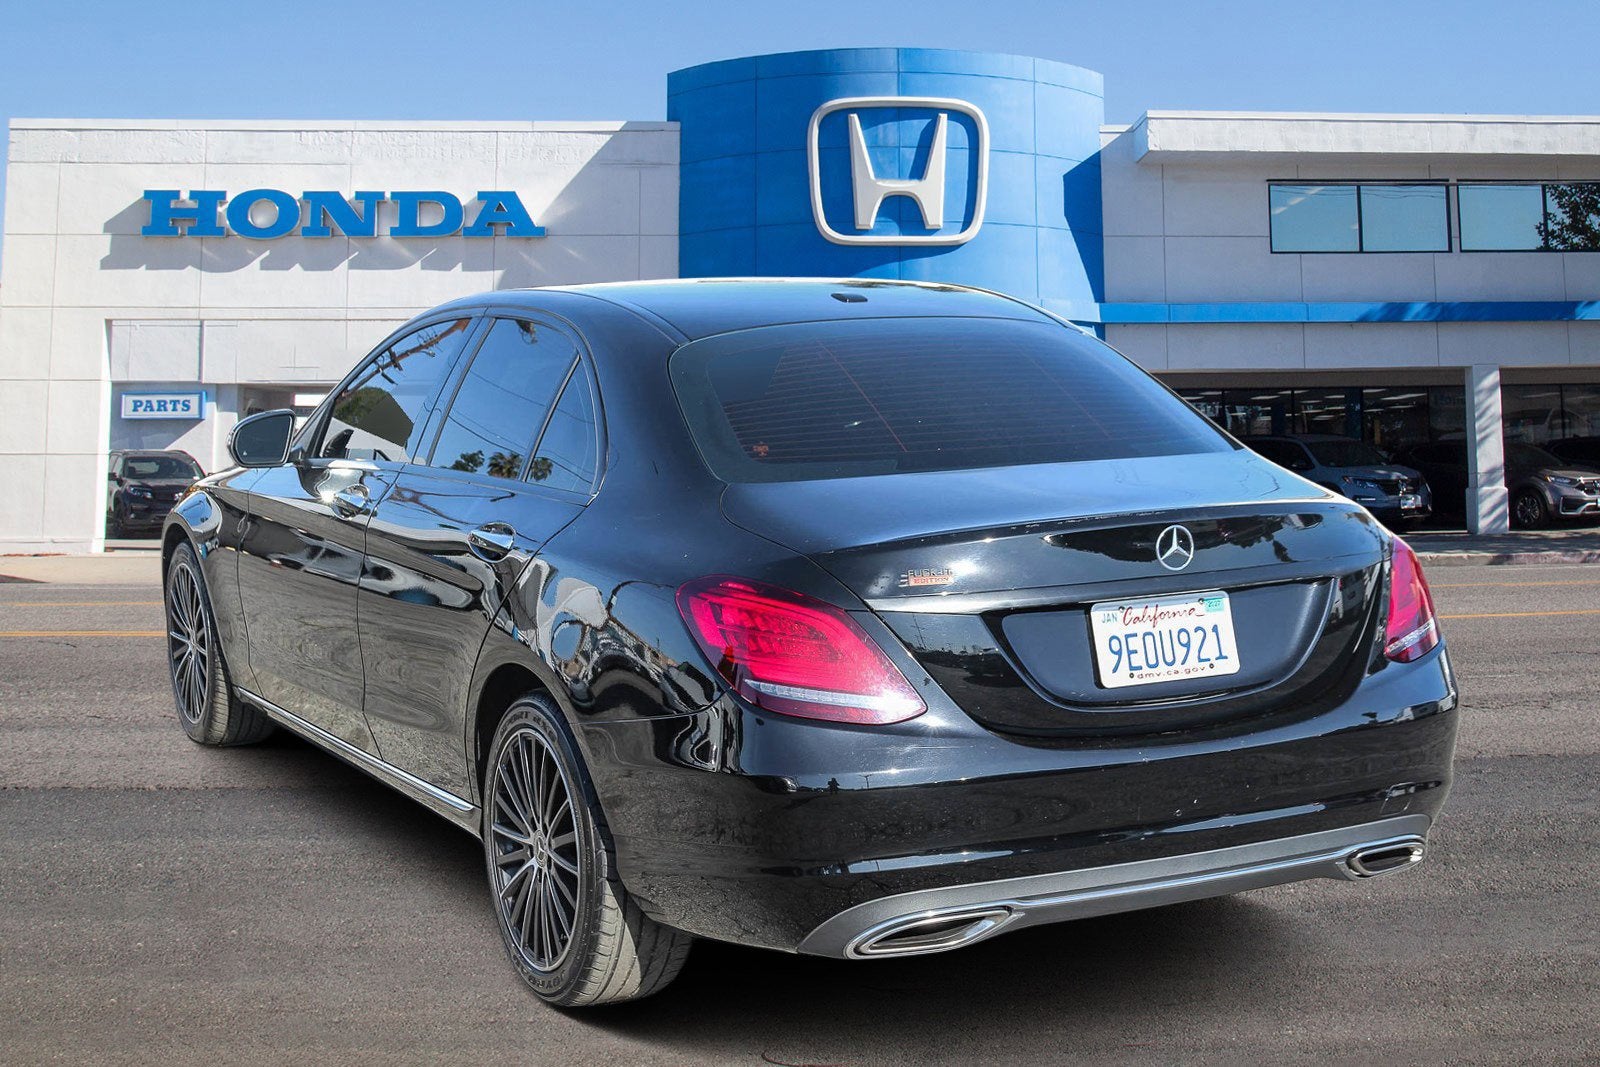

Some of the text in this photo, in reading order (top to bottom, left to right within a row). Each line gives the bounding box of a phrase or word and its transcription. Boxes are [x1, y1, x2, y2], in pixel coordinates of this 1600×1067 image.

[141, 189, 547, 239] HONDA
[132, 400, 191, 412] PARTS
[1101, 612, 1118, 624] JAN
[1122, 603, 1205, 628] California
[1136, 666, 1206, 680] dmv.ca.gov
